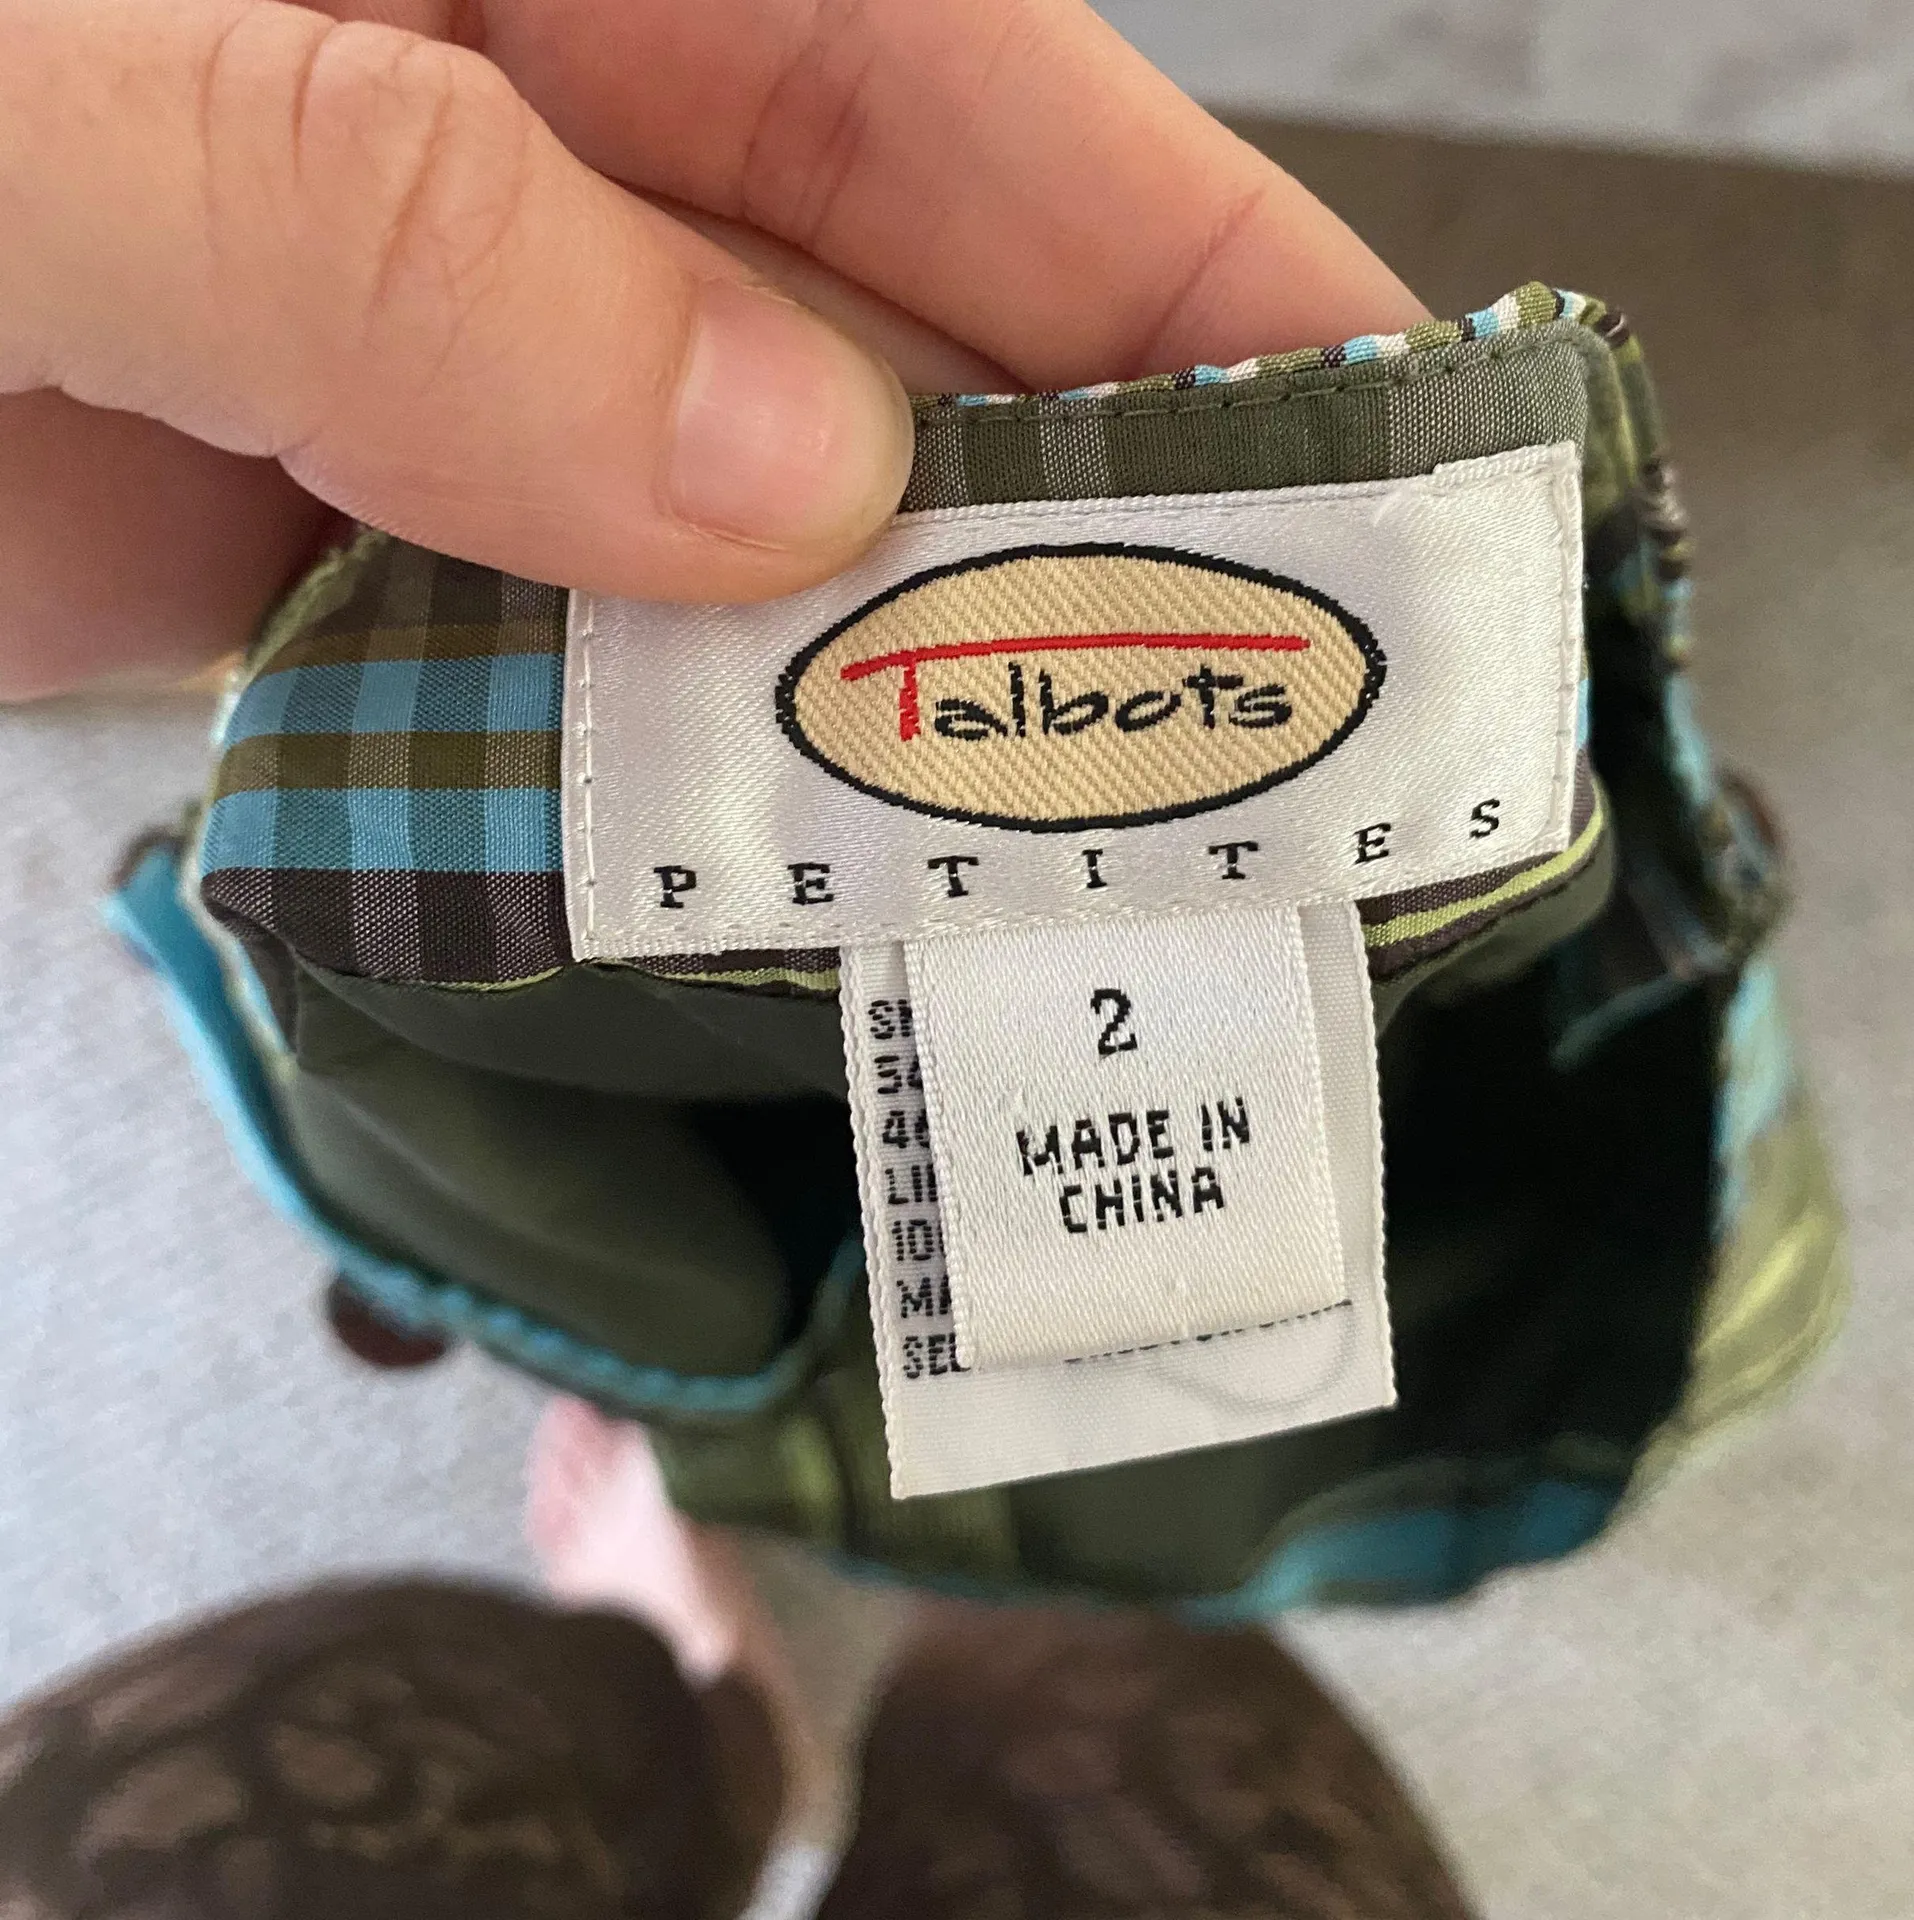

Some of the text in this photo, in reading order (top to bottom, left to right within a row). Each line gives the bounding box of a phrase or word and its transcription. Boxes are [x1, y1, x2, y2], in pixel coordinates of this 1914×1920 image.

[839, 631, 1311, 742] Talbots
[653, 799, 1502, 909] PETITES
[1089, 987, 1138, 1055] 2
[1015, 1096, 1250, 1177] MADE IN
[1058, 1166, 1225, 1234] CHINA
[891, 1218, 945, 1262] 10
